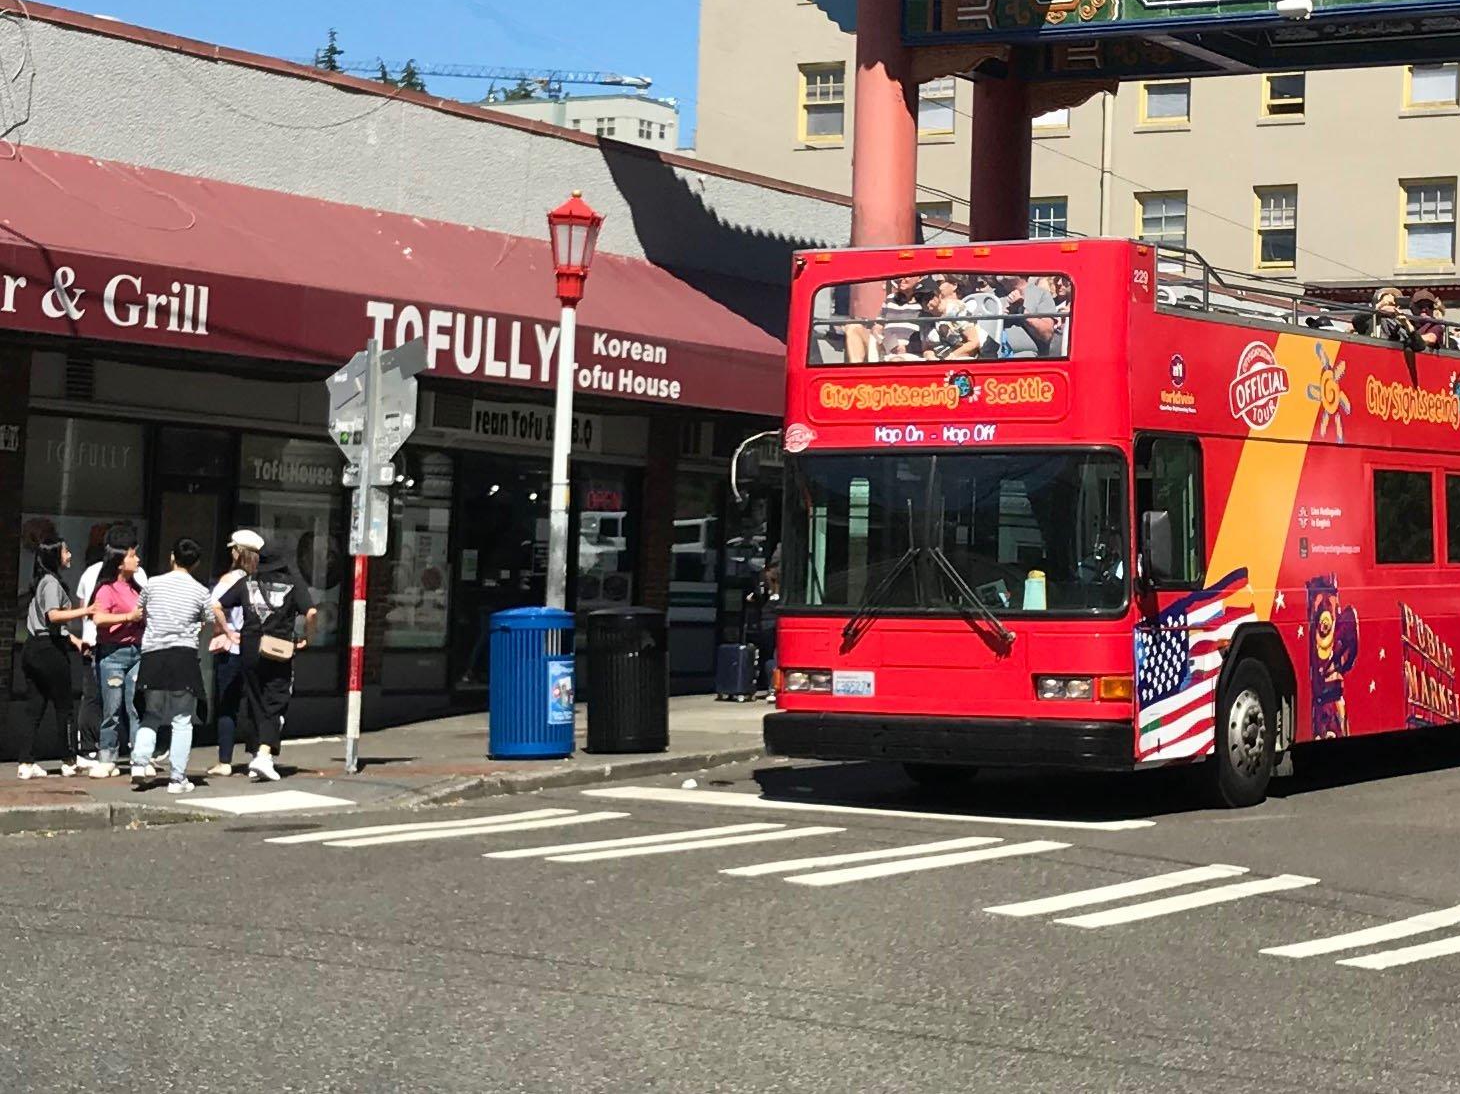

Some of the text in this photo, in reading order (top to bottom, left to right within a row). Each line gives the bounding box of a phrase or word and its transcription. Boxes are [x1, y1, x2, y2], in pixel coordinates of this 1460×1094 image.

[1133, 269, 1149, 285] 229
[41, 266, 86, 321] &
[103, 273, 209, 335] Grill
[593, 332, 667, 364] Korean
[618, 368, 681, 399] House
[983, 376, 1055, 405] Seattle
[1235, 370, 1288, 409] OFFICIAL
[512, 410, 543, 441] Tofu
[1252, 399, 1277, 424] TOUR
[874, 425, 902, 444] Hop
[905, 425, 924, 442] On
[942, 425, 970, 444] Hop
[973, 424, 997, 442] Off
[253, 457, 334, 485] Tofu House
[1404, 660, 1460, 720] MARKET
